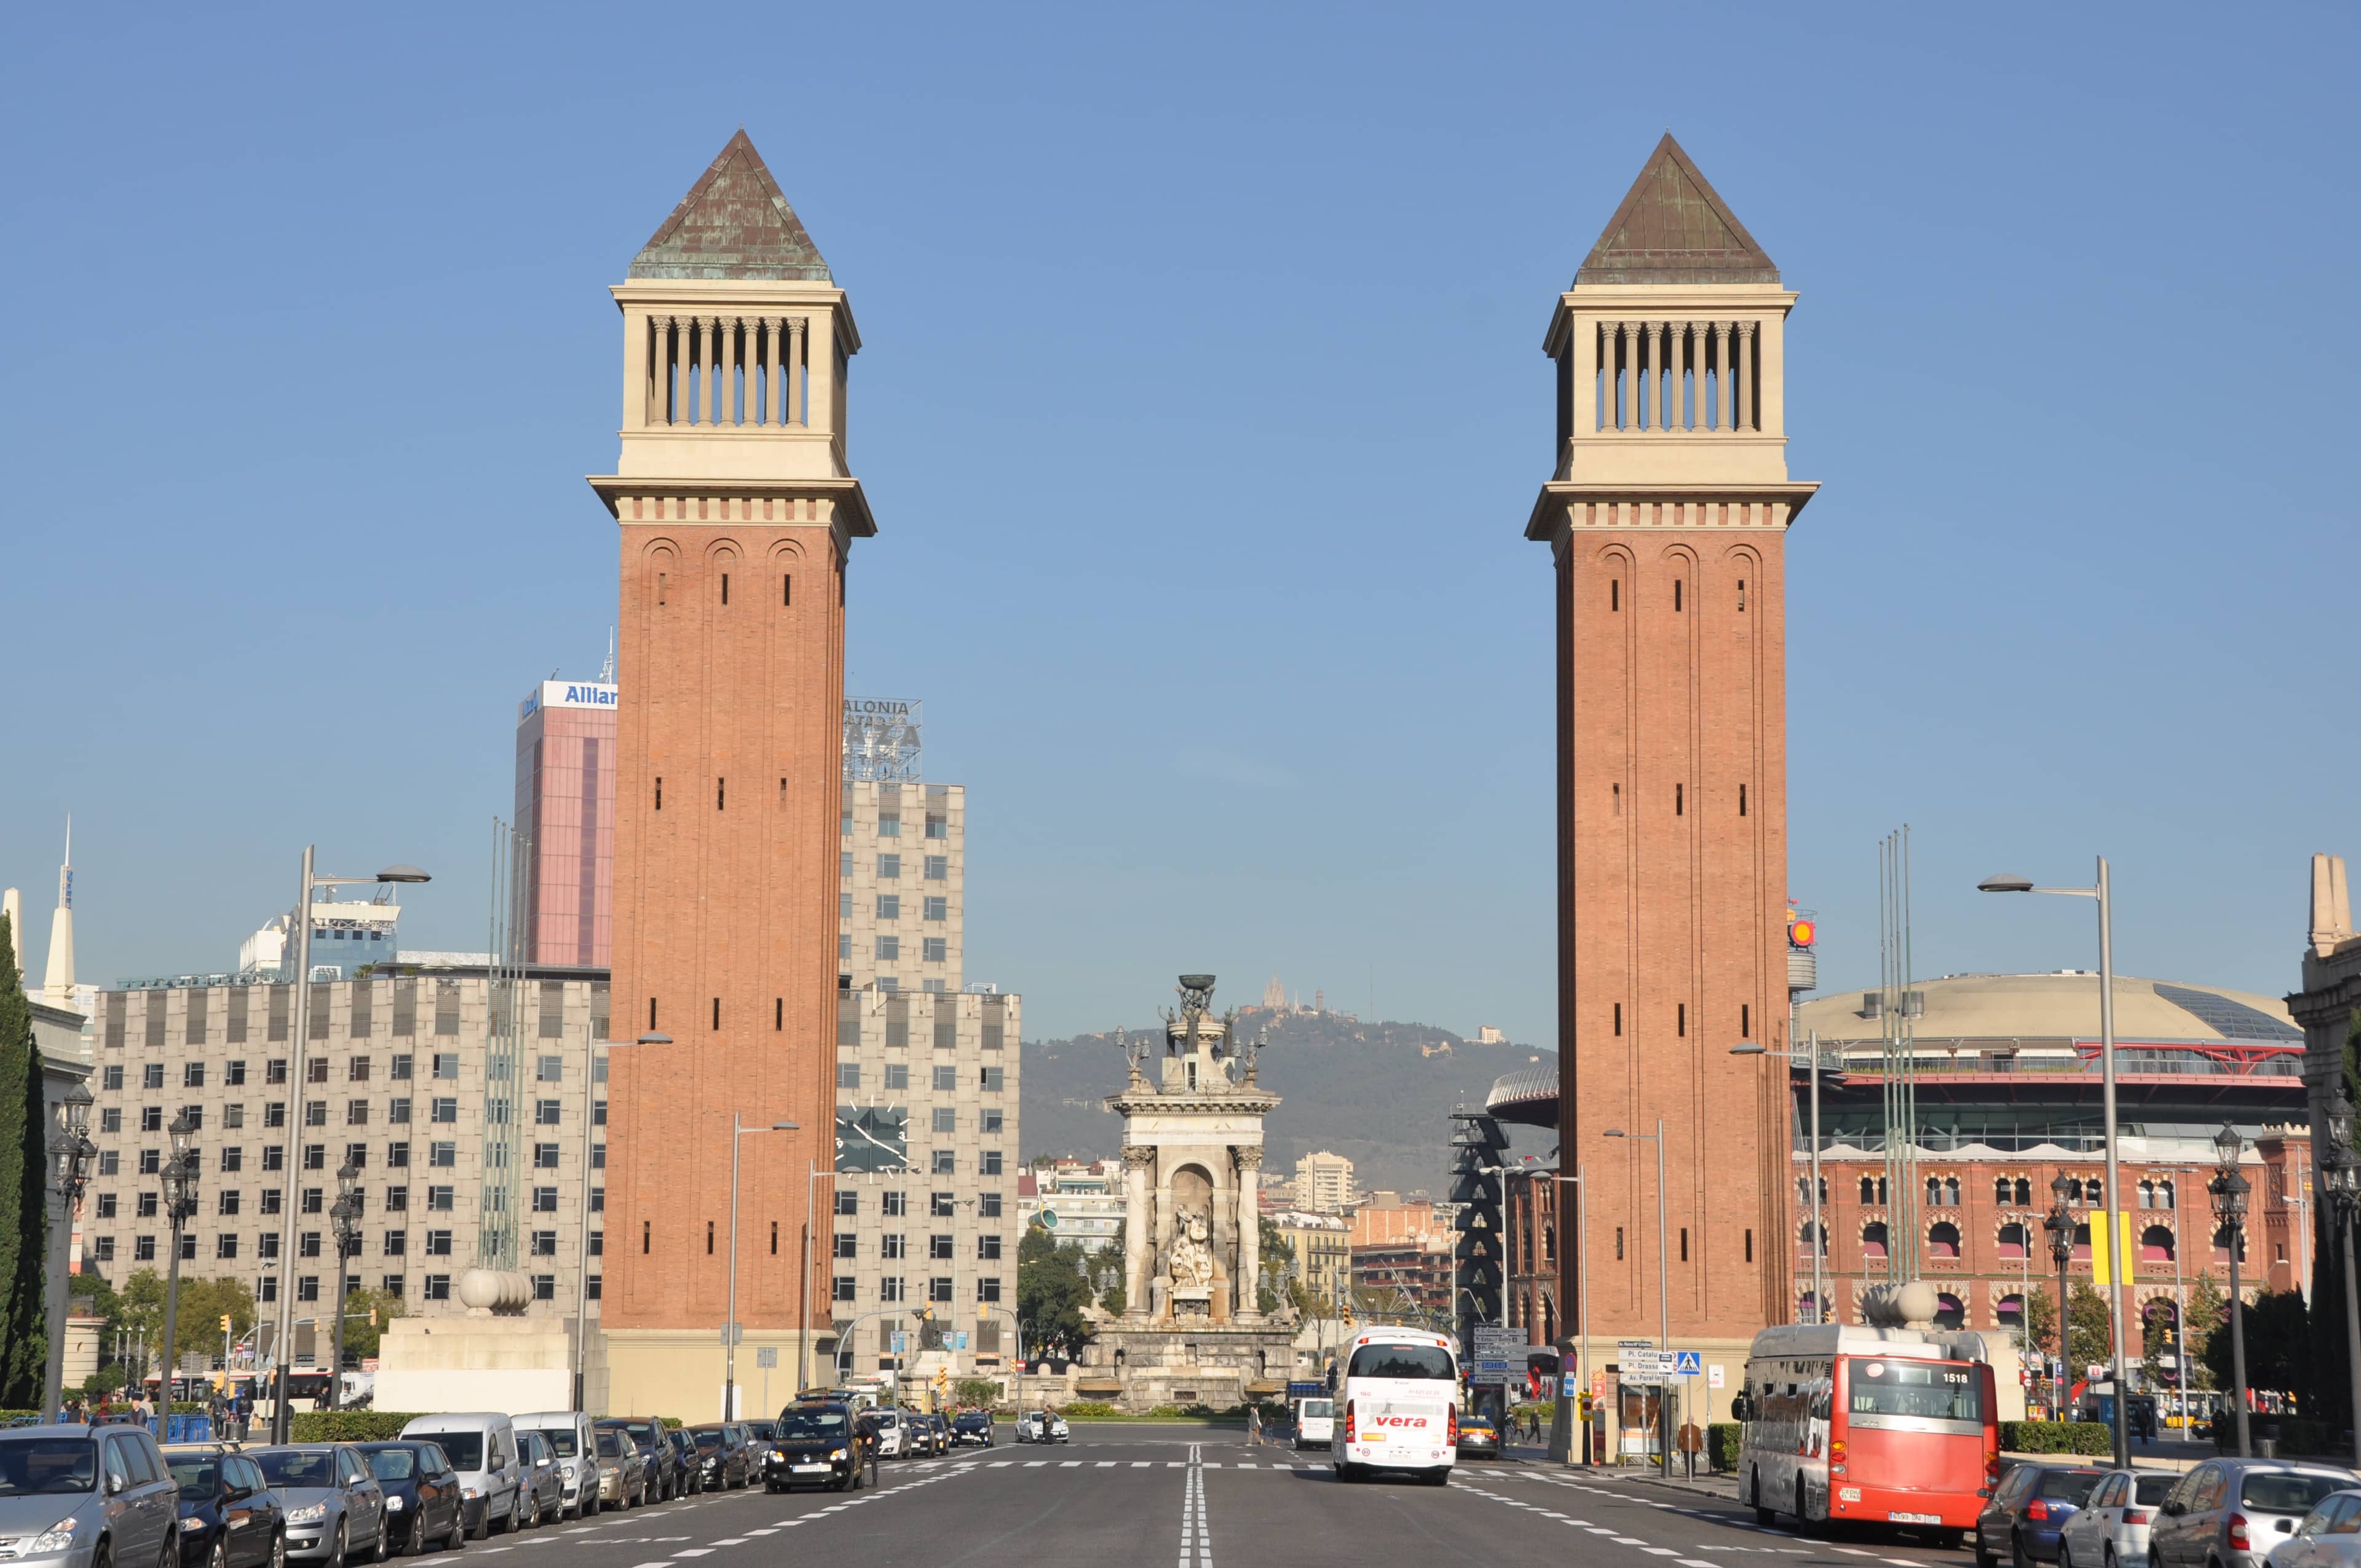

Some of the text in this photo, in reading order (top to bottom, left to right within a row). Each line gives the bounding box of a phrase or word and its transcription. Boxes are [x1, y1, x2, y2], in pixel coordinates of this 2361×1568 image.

[564, 686, 618, 705] Allian
[843, 700, 909, 715] ALONIA
[845, 724, 921, 748] AZA
[843, 753, 898, 765] OTEL
[898, 1131, 906, 1140] 3
[1944, 1373, 1968, 1383] 1518
[1376, 1416, 1427, 1427] vera
